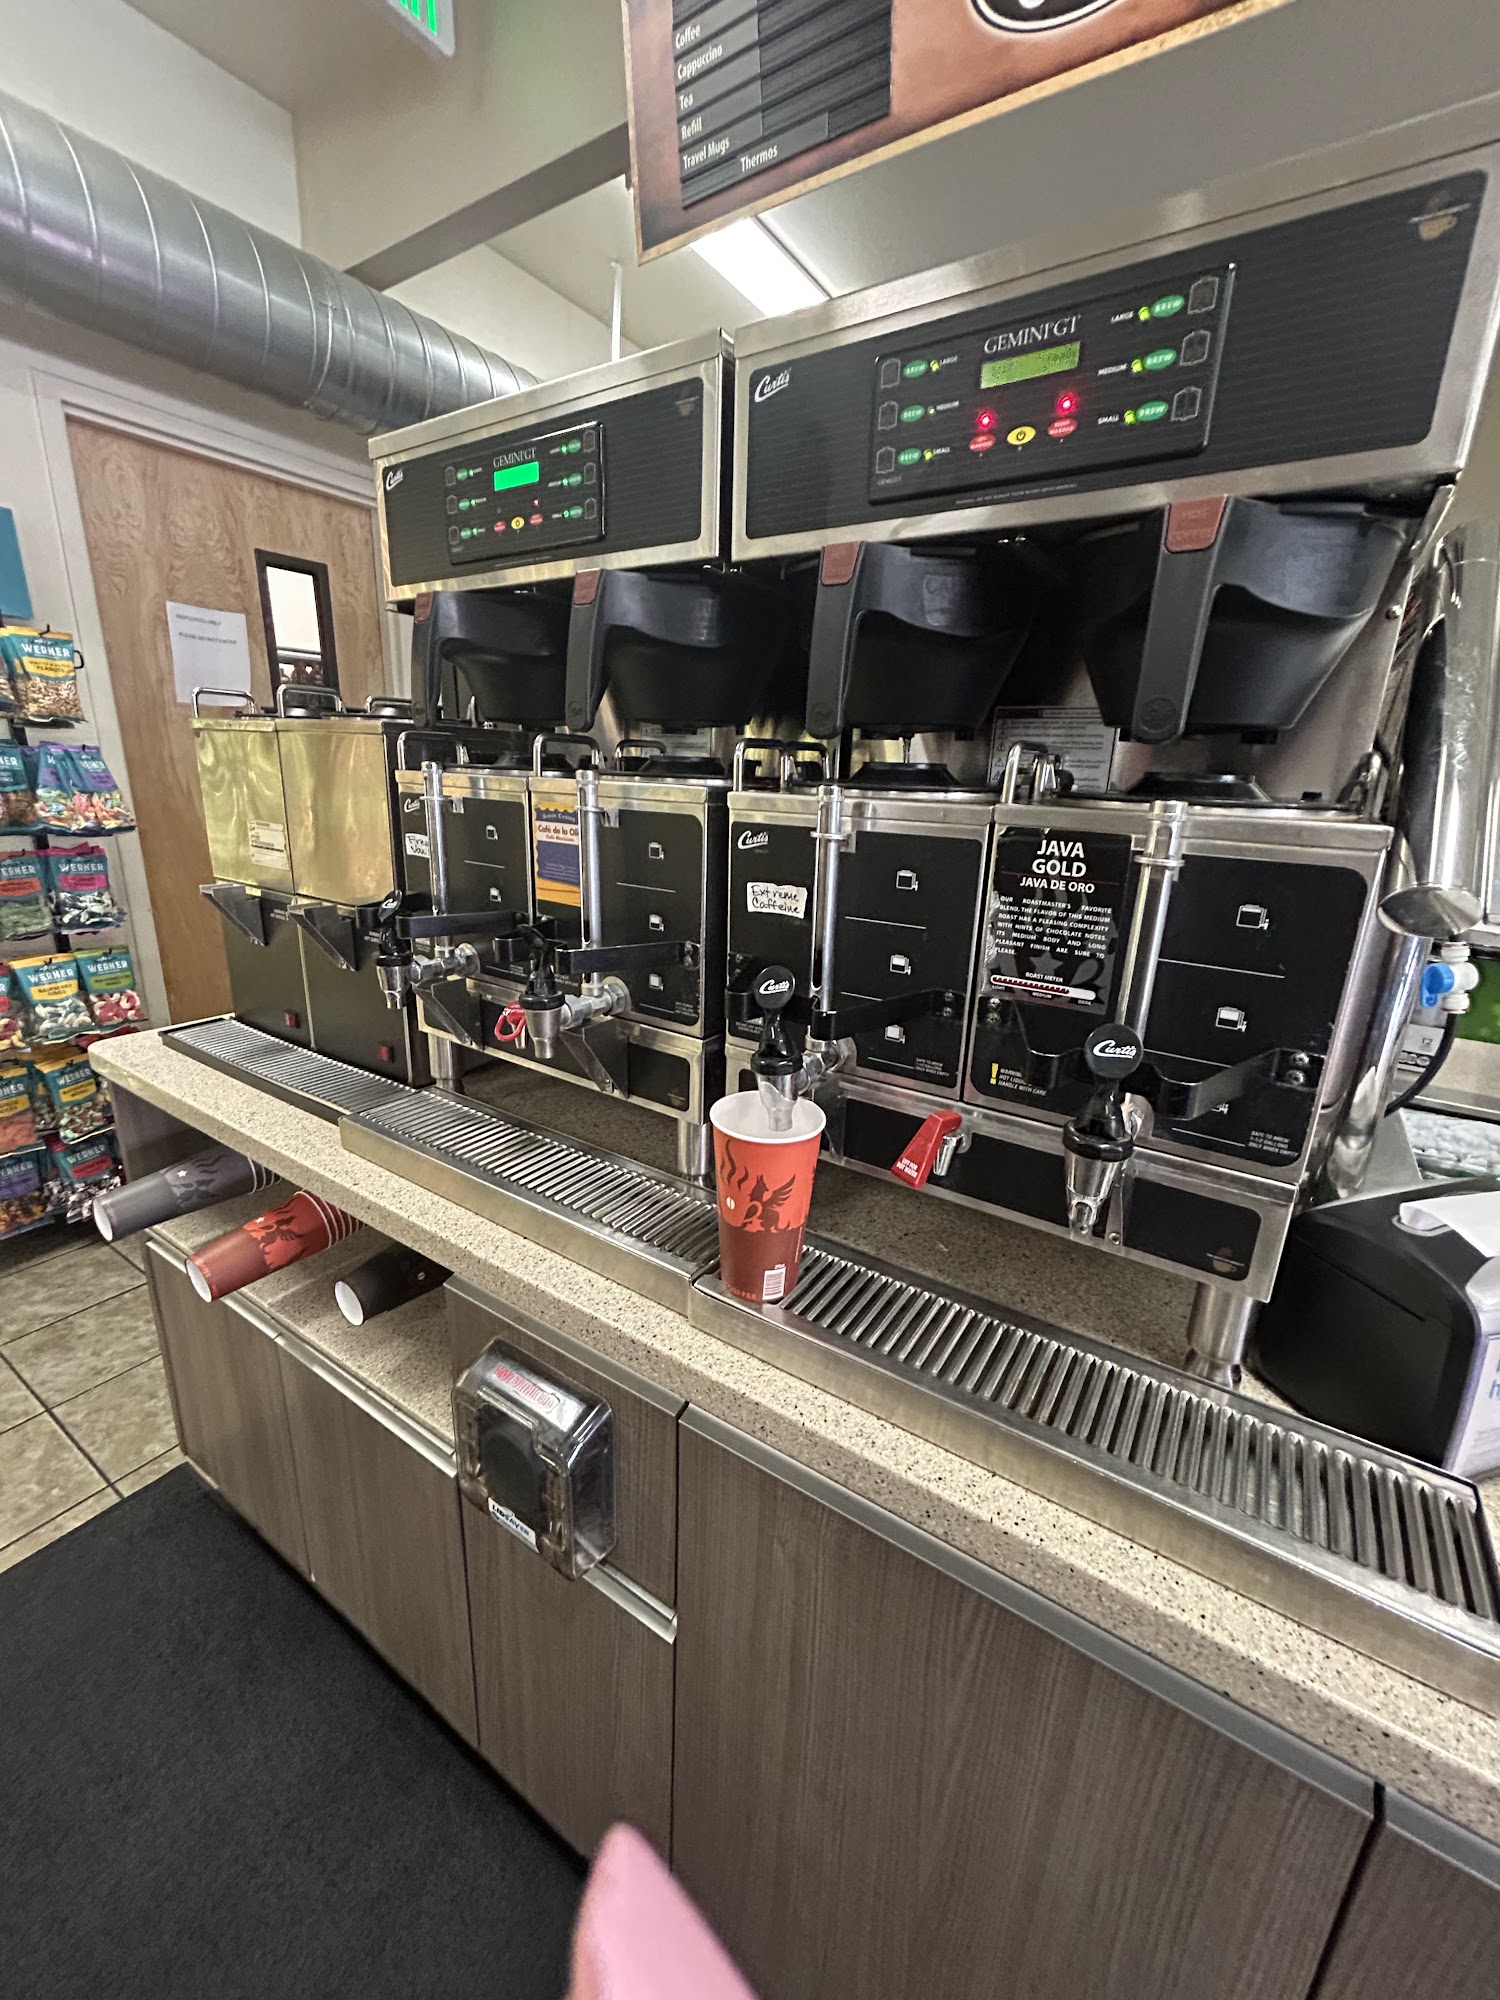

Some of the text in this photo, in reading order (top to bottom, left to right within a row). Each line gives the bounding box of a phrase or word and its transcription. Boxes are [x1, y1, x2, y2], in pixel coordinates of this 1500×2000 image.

[675, 24, 700, 49] Coffee
[677, 44, 723, 80] Cappuccino
[679, 93, 693, 110] Tea
[681, 116, 702, 140] Refill
[683, 137, 730, 169] Travel Mugs
[740, 145, 778, 172] Thermos
[21, 642, 70, 657] WERNER
[1036, 839, 1085, 858] JAVA
[59, 862, 105, 873] WERNER
[1031, 858, 1087, 878] GOLD
[751, 884, 800, 902] Extreme
[1019, 876, 1096, 894] JAVA DE ORO
[751, 896, 801, 914] Caffeine
[1000, 904, 1020, 912] BLEND,
[1021, 906, 1032, 914] THE
[1034, 908, 1057, 916] FLAVOR
[1068, 912, 1082, 920] THIS
[1083, 914, 1111, 923] MEDIUM
[1022, 898, 1071, 909] ROASTMASTER'S
[1081, 905, 1112, 914] FAVORITE
[997, 921, 1013, 929] WITH
[1046, 927, 1082, 938] CHOCOLATE
[1038, 918, 1068, 927] PLEASING
[1069, 921, 1109, 932] COMPLEXITY
[995, 939, 1025, 947] PLEASANT
[1030, 943, 1050, 951] FINISH
[1074, 949, 1091, 957] SURE
[1012, 932, 1037, 940] MEDIUM
[1043, 936, 1061, 944] BODY
[1088, 942, 1107, 950] LONG
[28, 968, 75, 983] WERNER
[87, 960, 129, 973] WERNER
[1025, 971, 1064, 983] ROAST METER
[1093, 1039, 1137, 1059] Curtis
